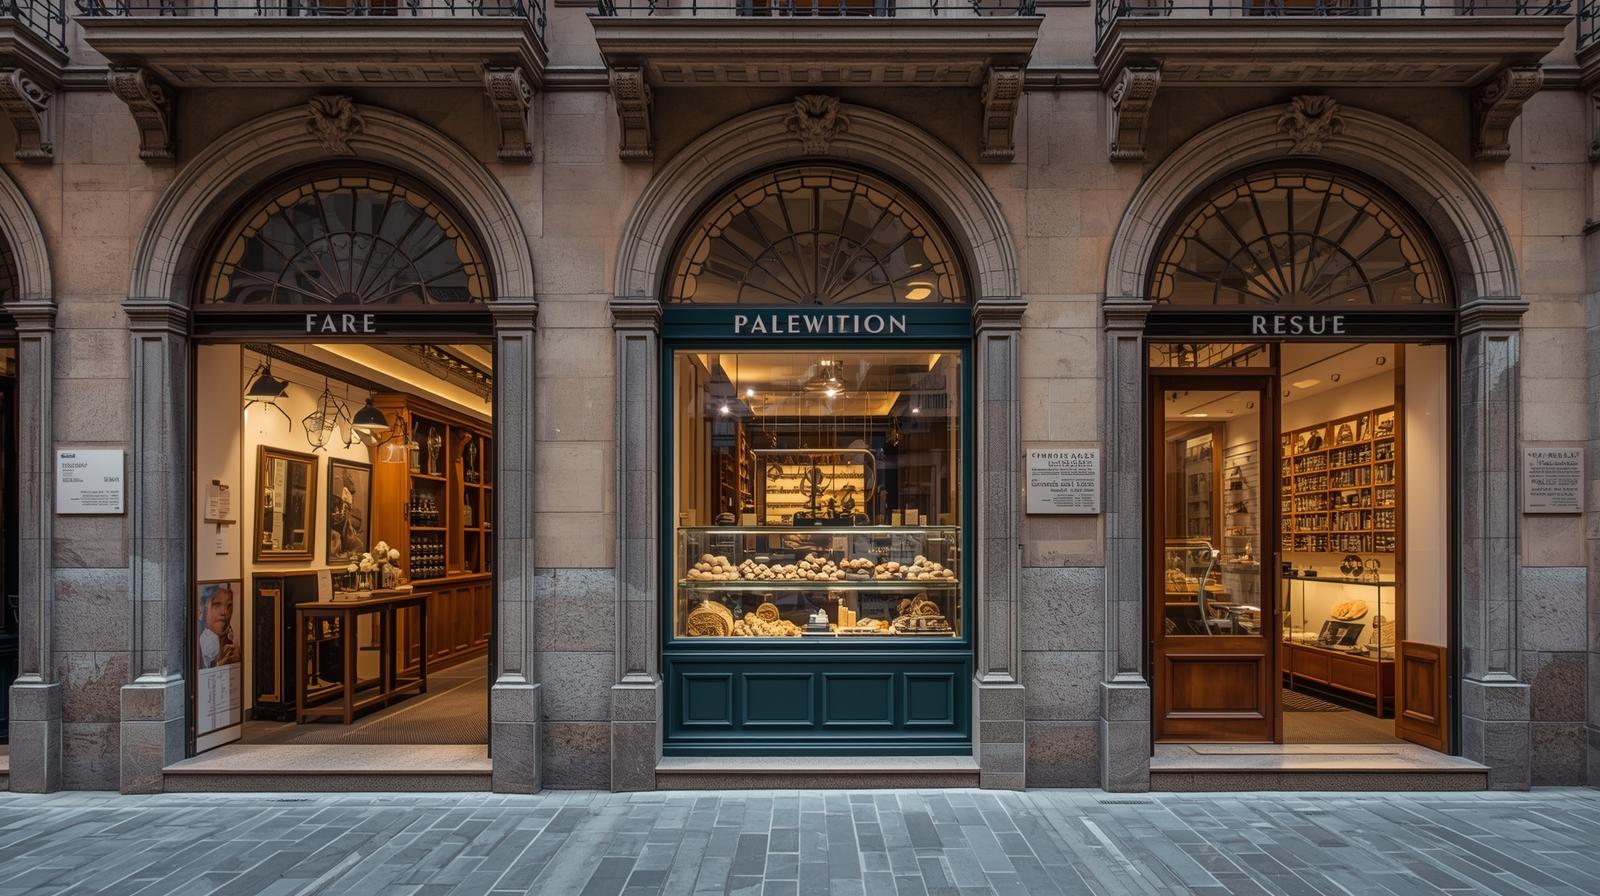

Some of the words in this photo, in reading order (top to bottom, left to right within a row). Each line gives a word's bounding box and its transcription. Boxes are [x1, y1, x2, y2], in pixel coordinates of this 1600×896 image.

[306, 314, 376, 333] FARE
[734, 314, 906, 334] PALEWITION
[1252, 315, 1345, 334] RESUE
